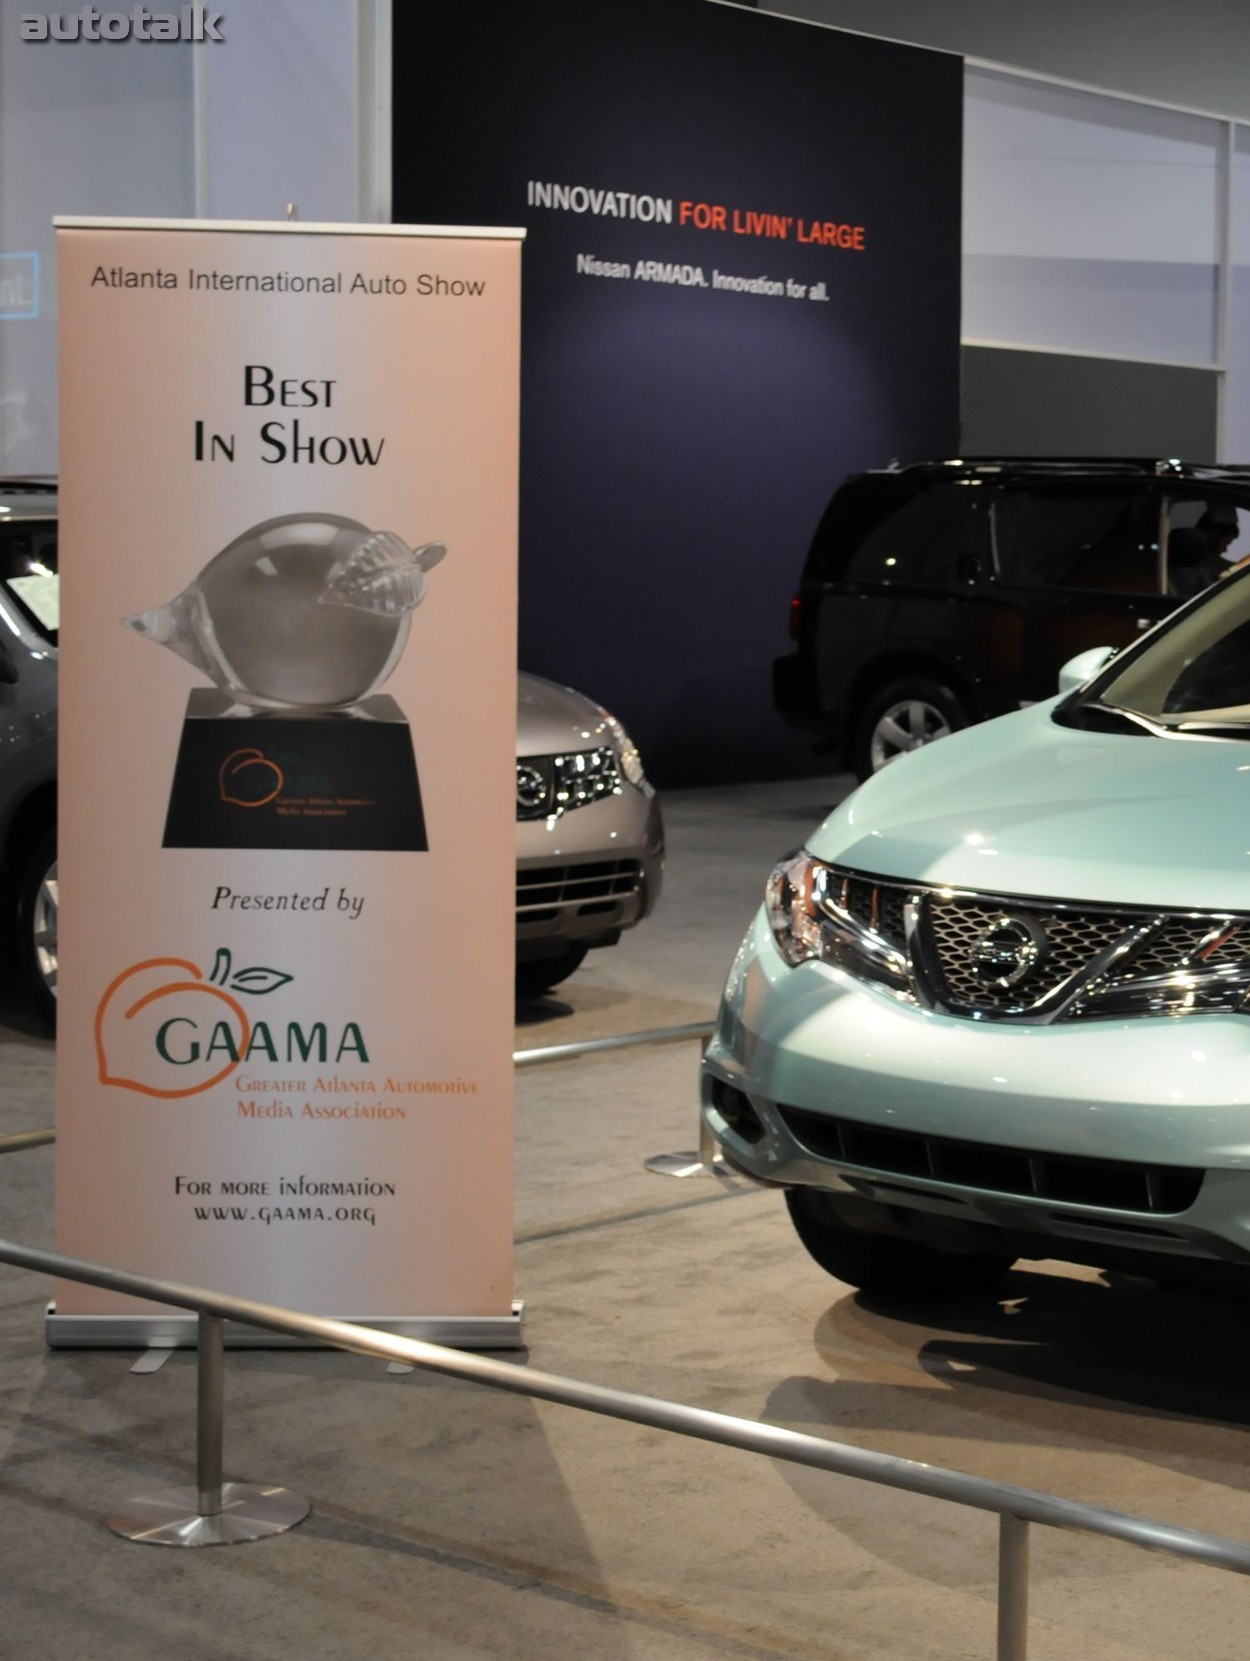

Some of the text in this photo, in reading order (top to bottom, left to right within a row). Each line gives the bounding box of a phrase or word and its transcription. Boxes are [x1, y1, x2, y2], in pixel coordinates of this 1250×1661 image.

[528, 180, 865, 250] INNOVATION FOR LIVIN' LARGE
[91, 265, 486, 297] Atlanta International Auto Show
[576, 253, 830, 301] Nissan ARMADA. Innovation for all.
[211, 886, 364, 919] Presented by
[155, 1017, 370, 1066] GAAMA
